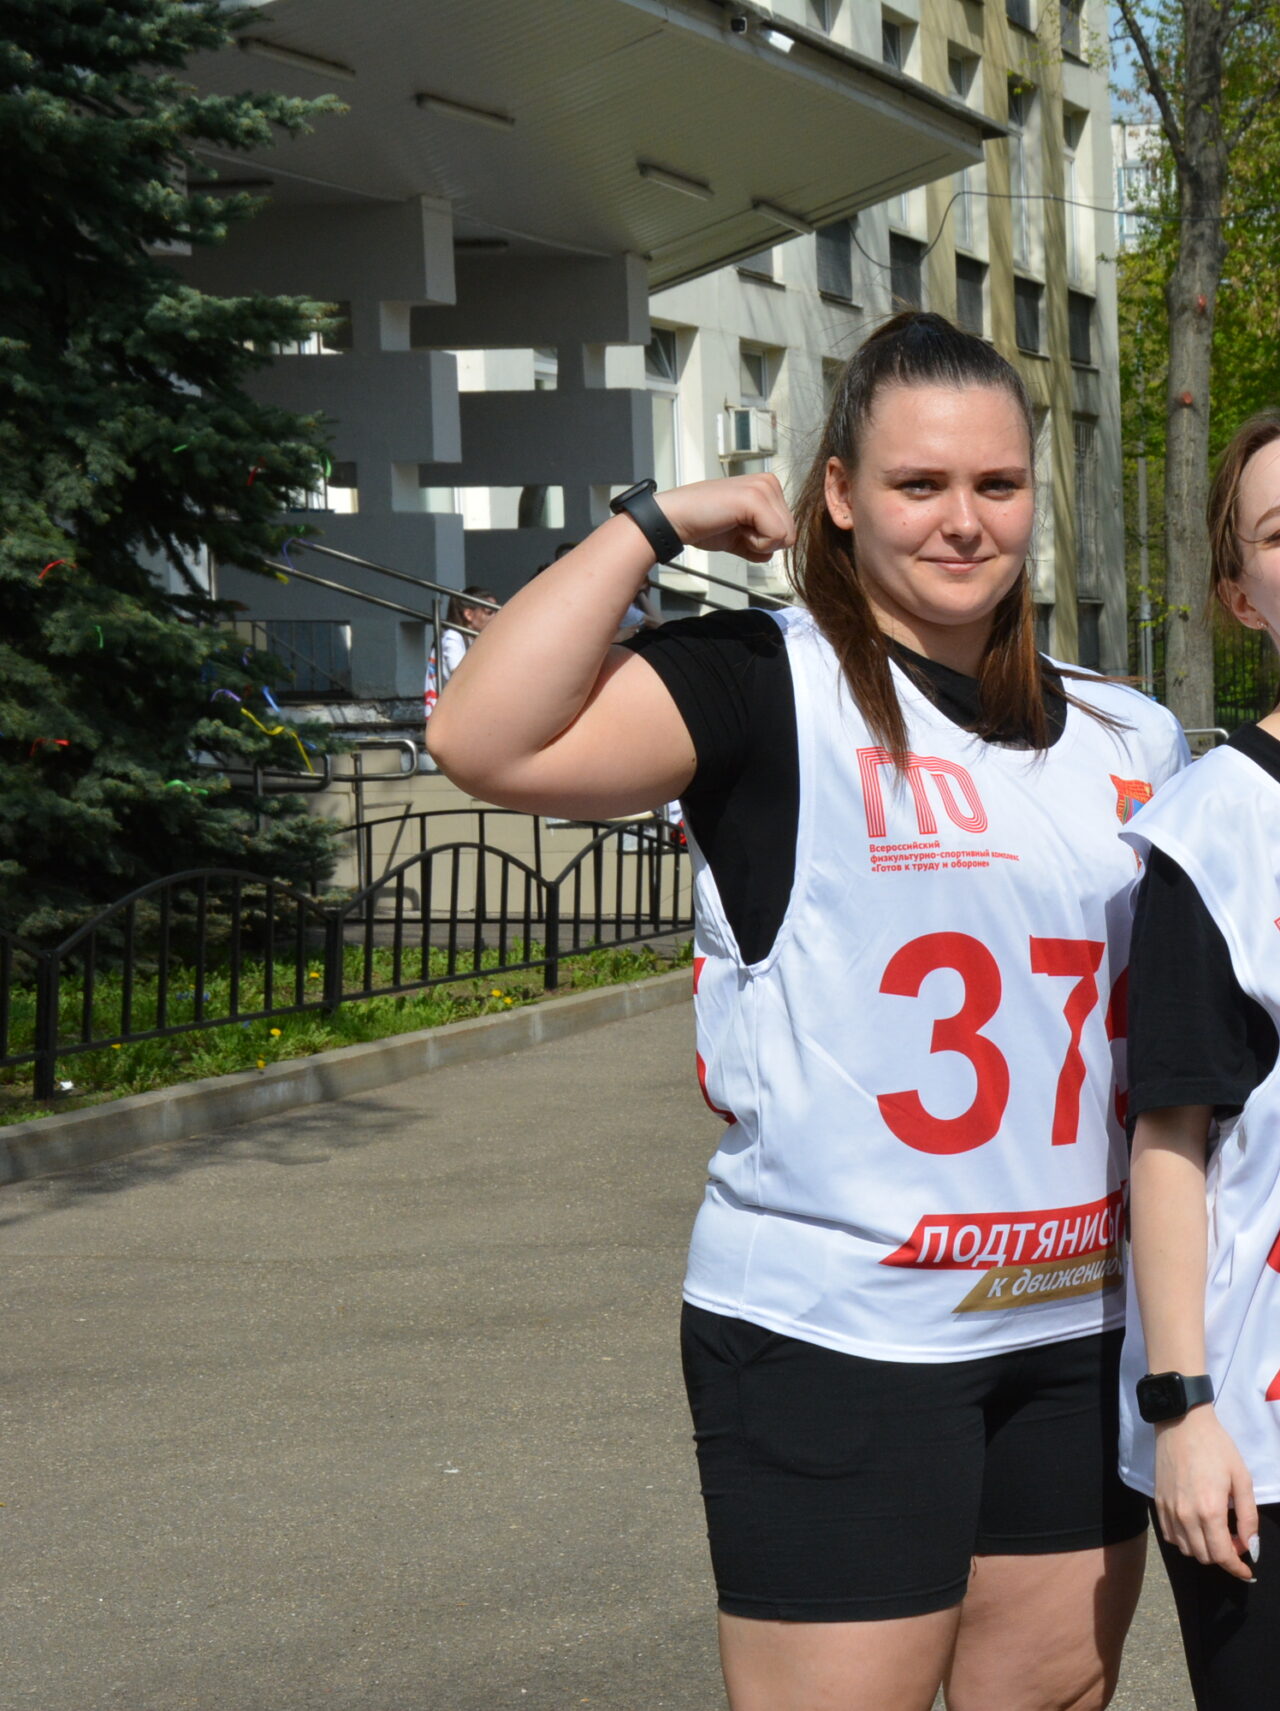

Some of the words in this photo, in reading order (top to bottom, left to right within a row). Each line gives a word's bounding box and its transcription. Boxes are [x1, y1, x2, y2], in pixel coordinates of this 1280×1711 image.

[869, 840, 940, 853] Всероссийский
[870, 850, 990, 864] физкультурно-спортивный
[871, 863, 902, 873] «Готов
[912, 861, 939, 872] труду
[987, 1277, 1008, 1298] к
